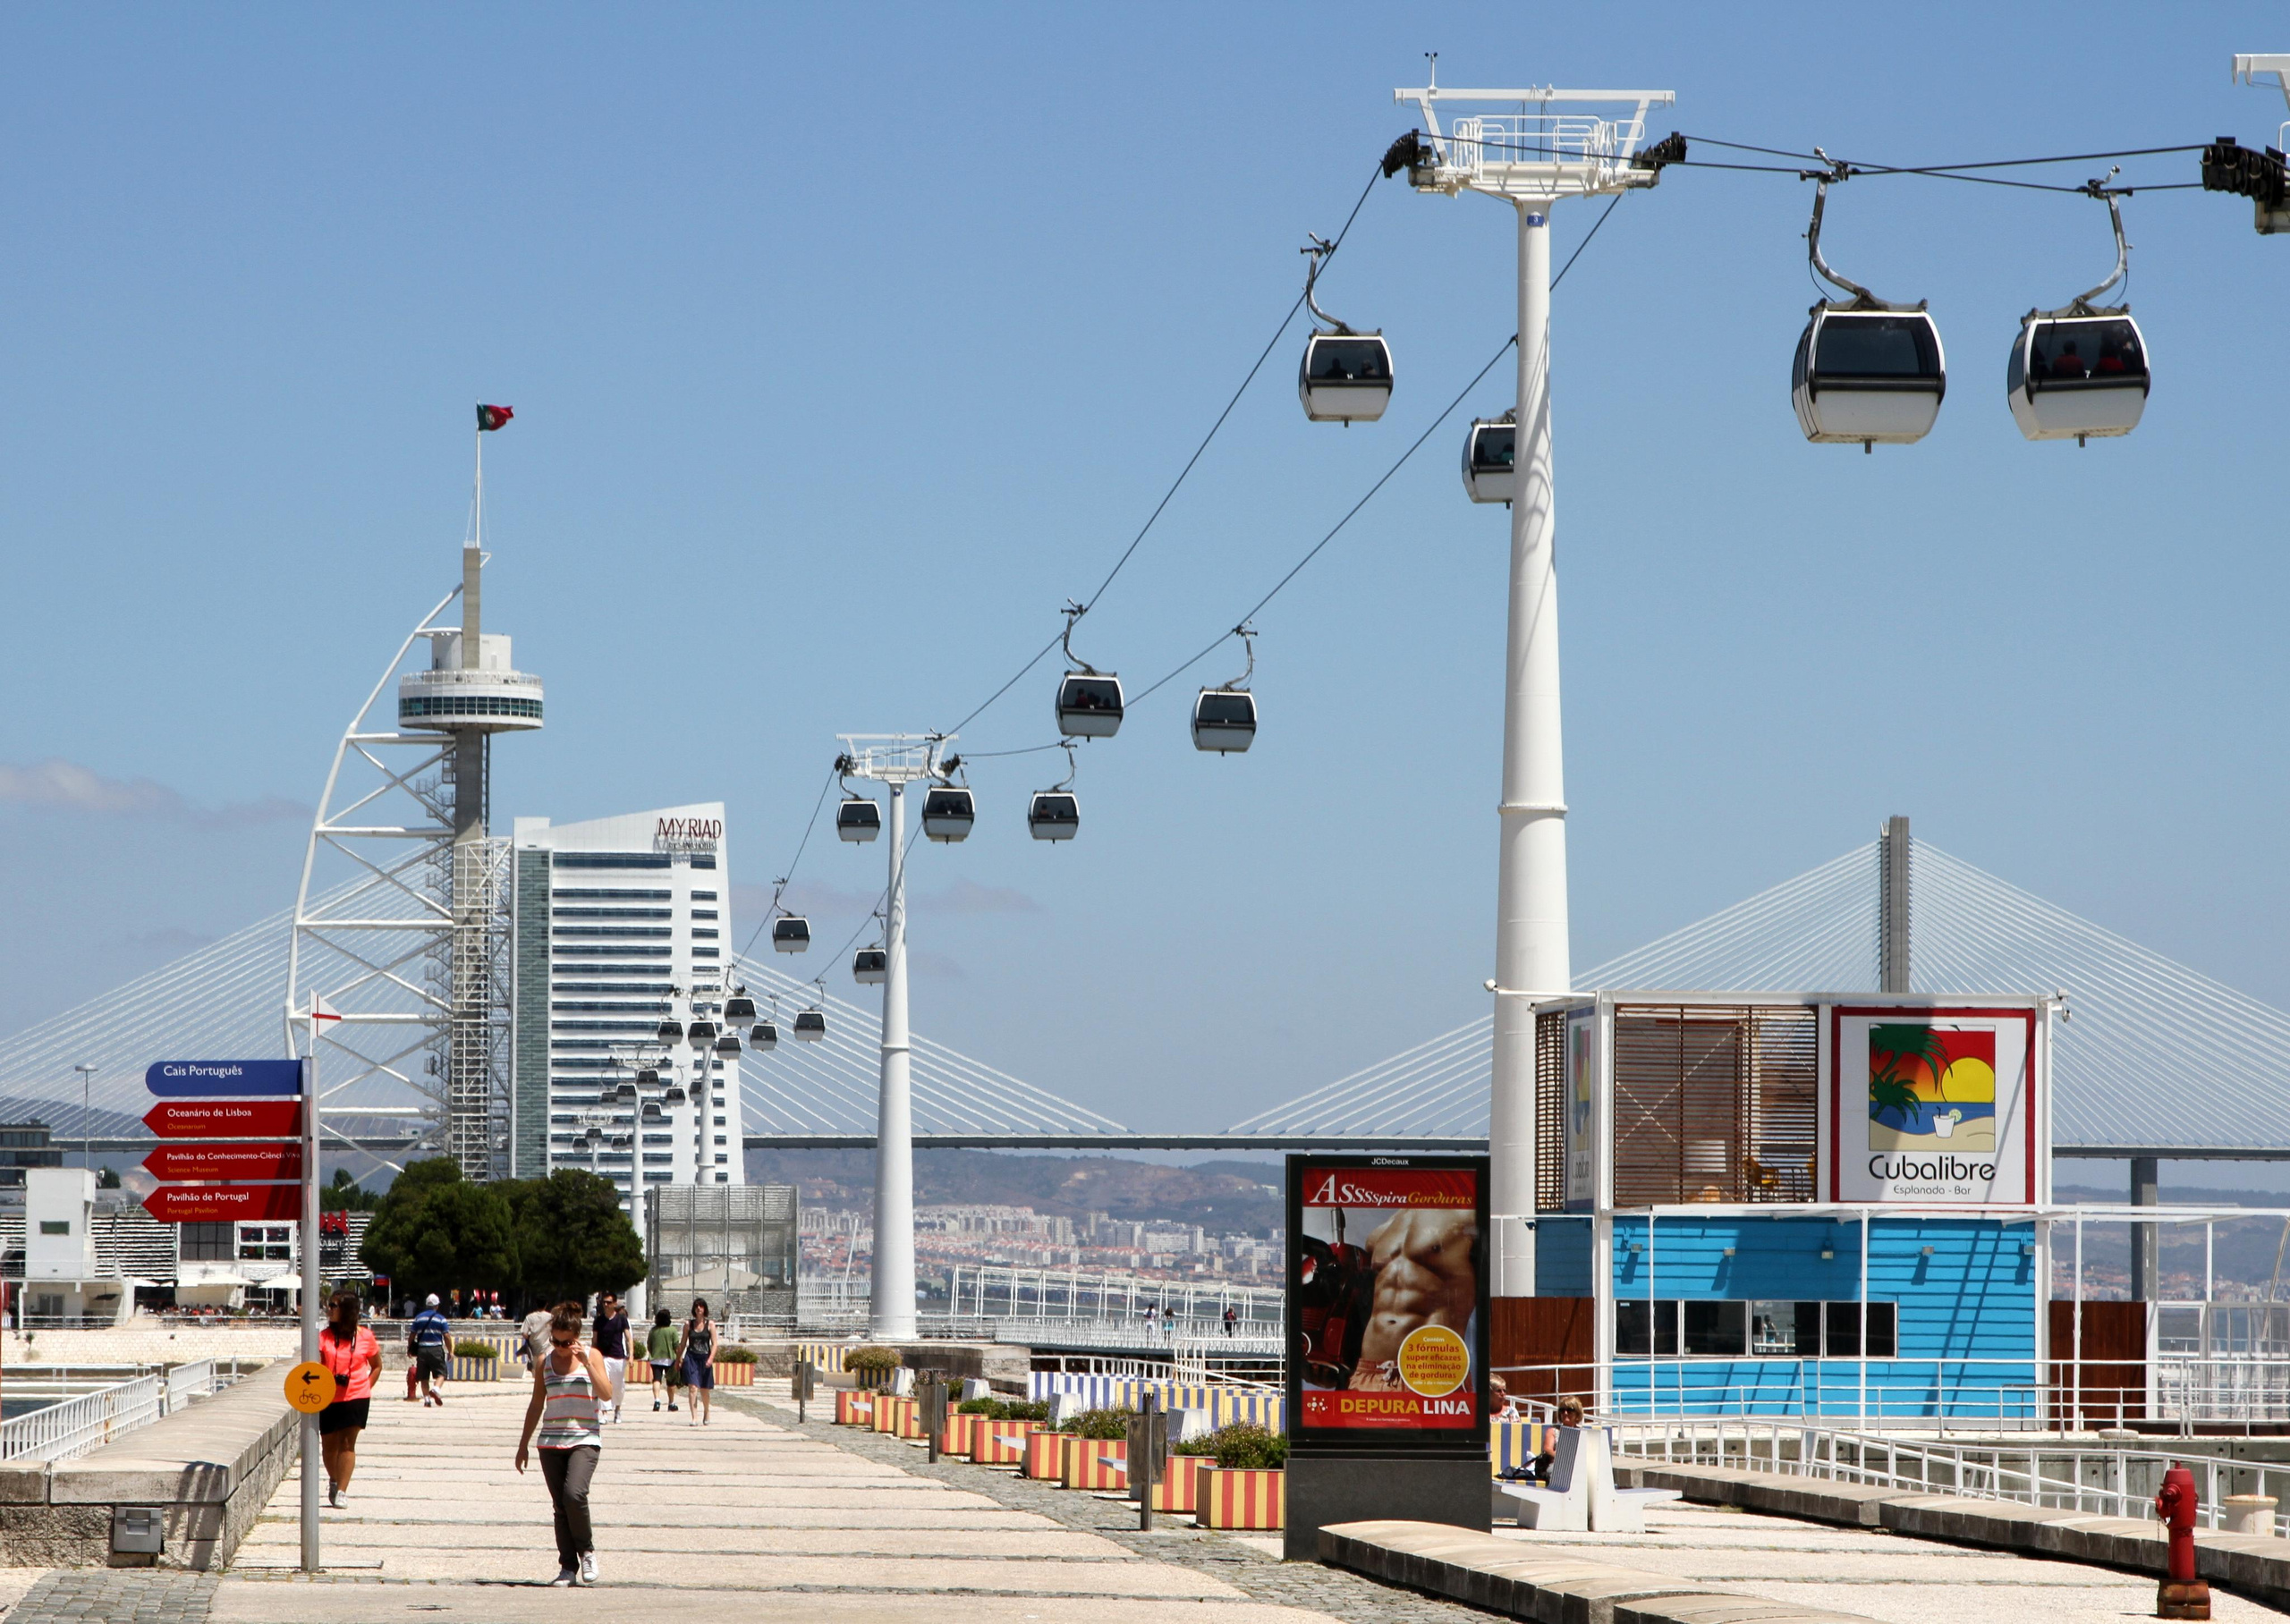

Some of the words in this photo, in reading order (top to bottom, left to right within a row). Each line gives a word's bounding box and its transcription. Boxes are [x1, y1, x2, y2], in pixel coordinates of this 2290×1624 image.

[2084, 369, 2091, 378] 7
[657, 817, 722, 839] MYRIAD
[163, 1065, 186, 1076] Cais
[189, 1064, 242, 1078] Português
[167, 1108, 210, 1117] Oceanário
[213, 1109, 224, 1117] de
[225, 1108, 251, 1117] Lisboa
[166, 1153, 194, 1161] Pavilhão
[1371, 1157, 1410, 1165] JCDecaux
[1868, 1155, 1996, 1181] Cubalibre
[1893, 1185, 1946, 1197] Esplanada
[1954, 1185, 1972, 1195] Bar
[166, 1193, 199, 1202] Pavilhão
[202, 1192, 213, 1201] de
[215, 1192, 250, 1202] Portugal
[166, 1207, 193, 1215] Portugal
[1408, 1343, 1413, 1352] 3
[1416, 1343, 1459, 1352] fórmulas
[1406, 1354, 1429, 1362] super
[1430, 1353, 1461, 1361] eficazes
[1418, 1363, 1462, 1371] eliminação
[1421, 1371, 1456, 1380] gorduras
[1341, 1399, 1420, 1414] DEPURA
[1423, 1400, 1471, 1415] LINA
